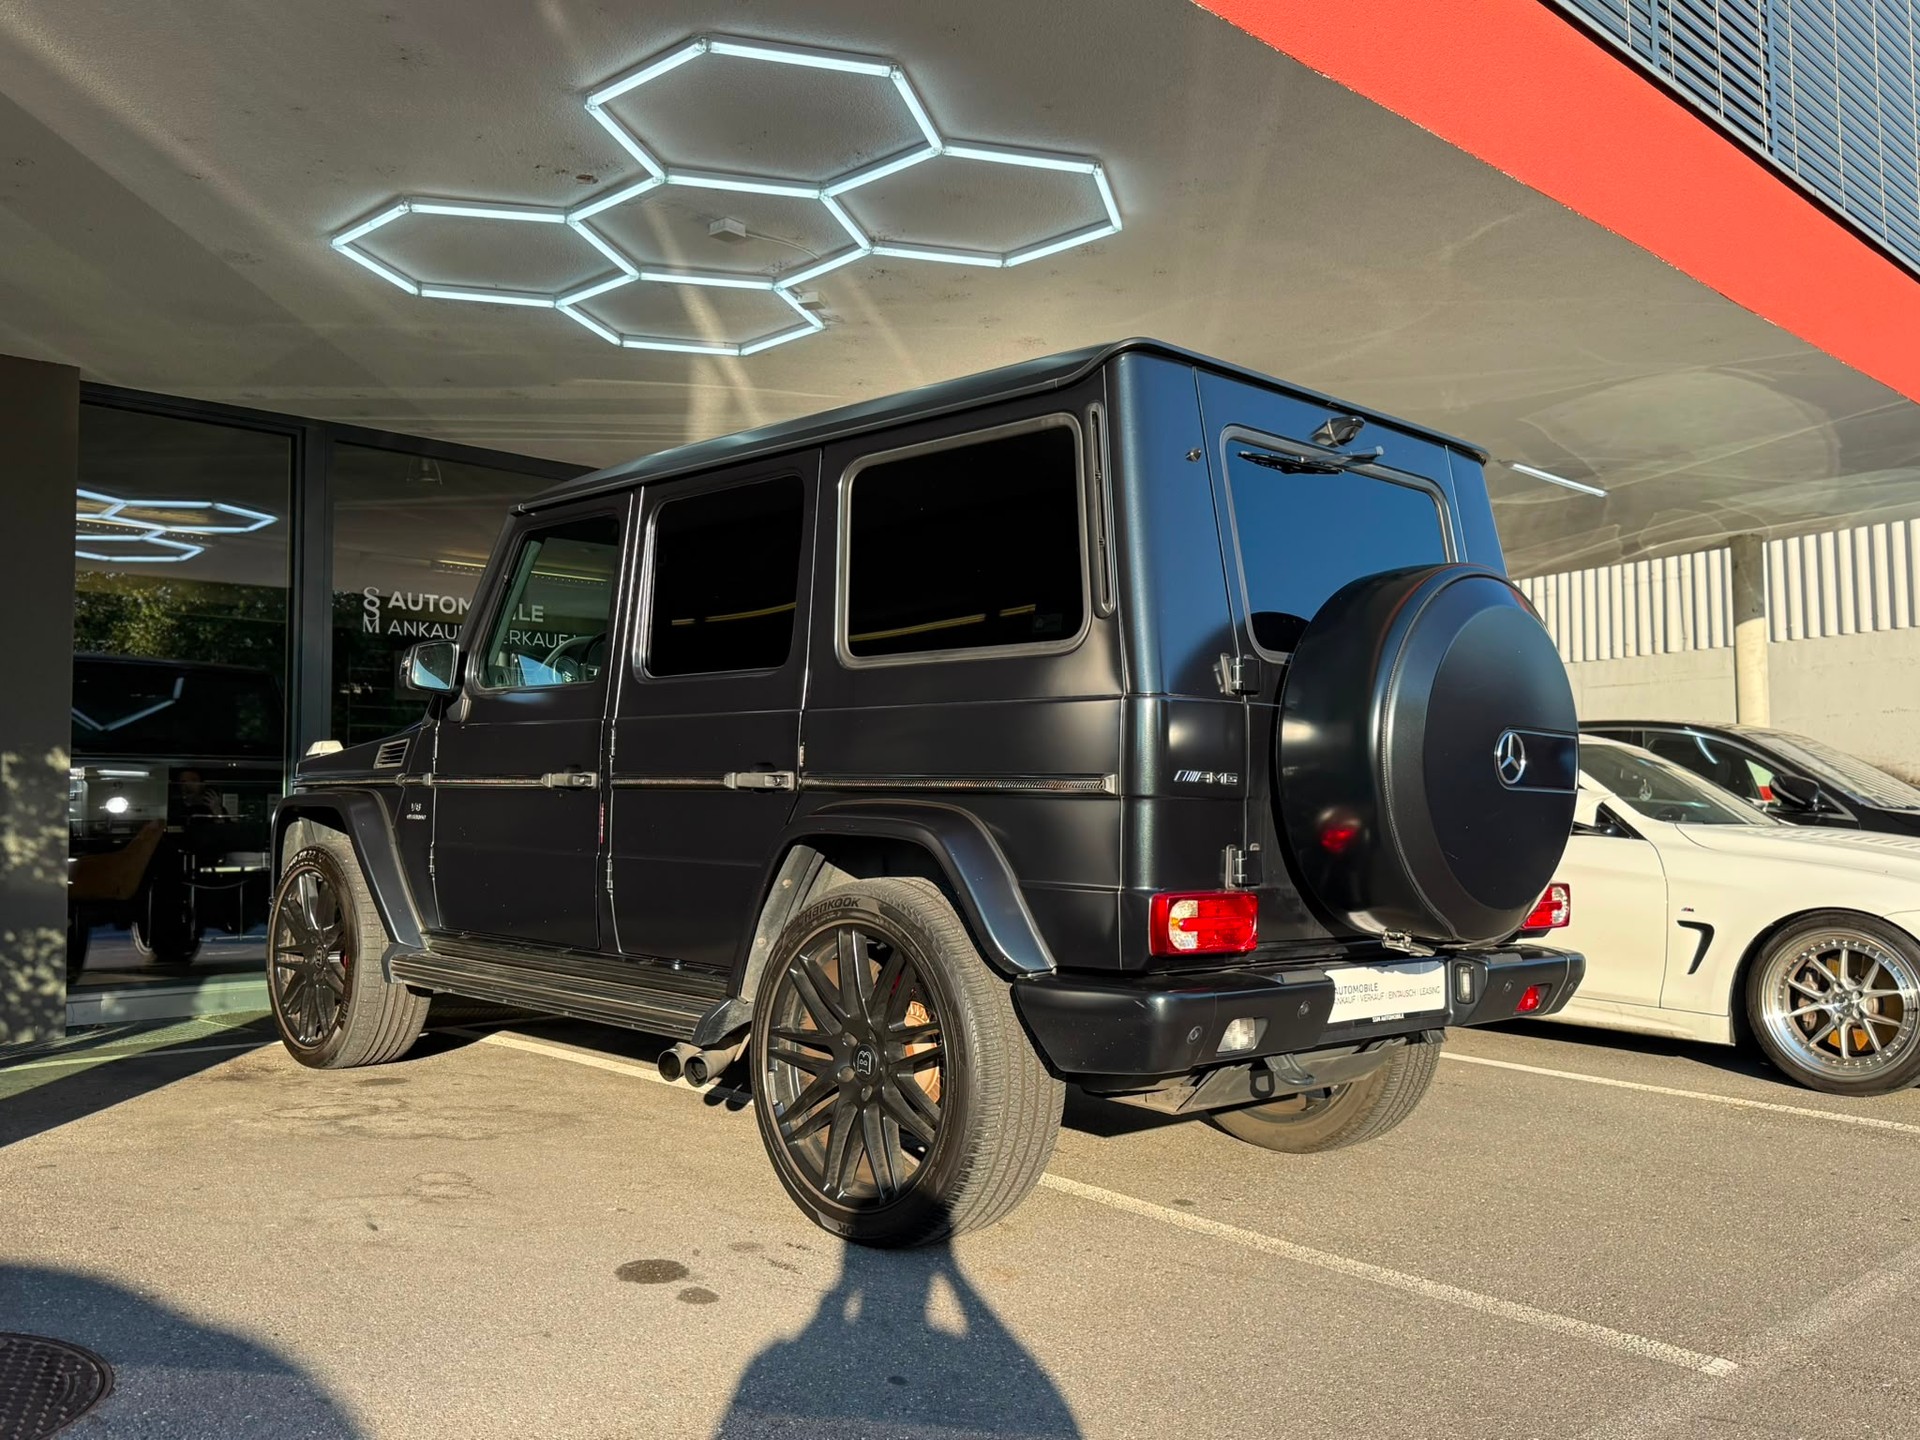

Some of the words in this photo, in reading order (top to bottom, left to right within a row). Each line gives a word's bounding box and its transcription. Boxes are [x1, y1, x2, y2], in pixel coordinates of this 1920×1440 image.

[388, 591, 544, 623] AUTOMLE
[388, 619, 463, 640] ANKAU
[1334, 994, 1357, 1006] NKAUF
